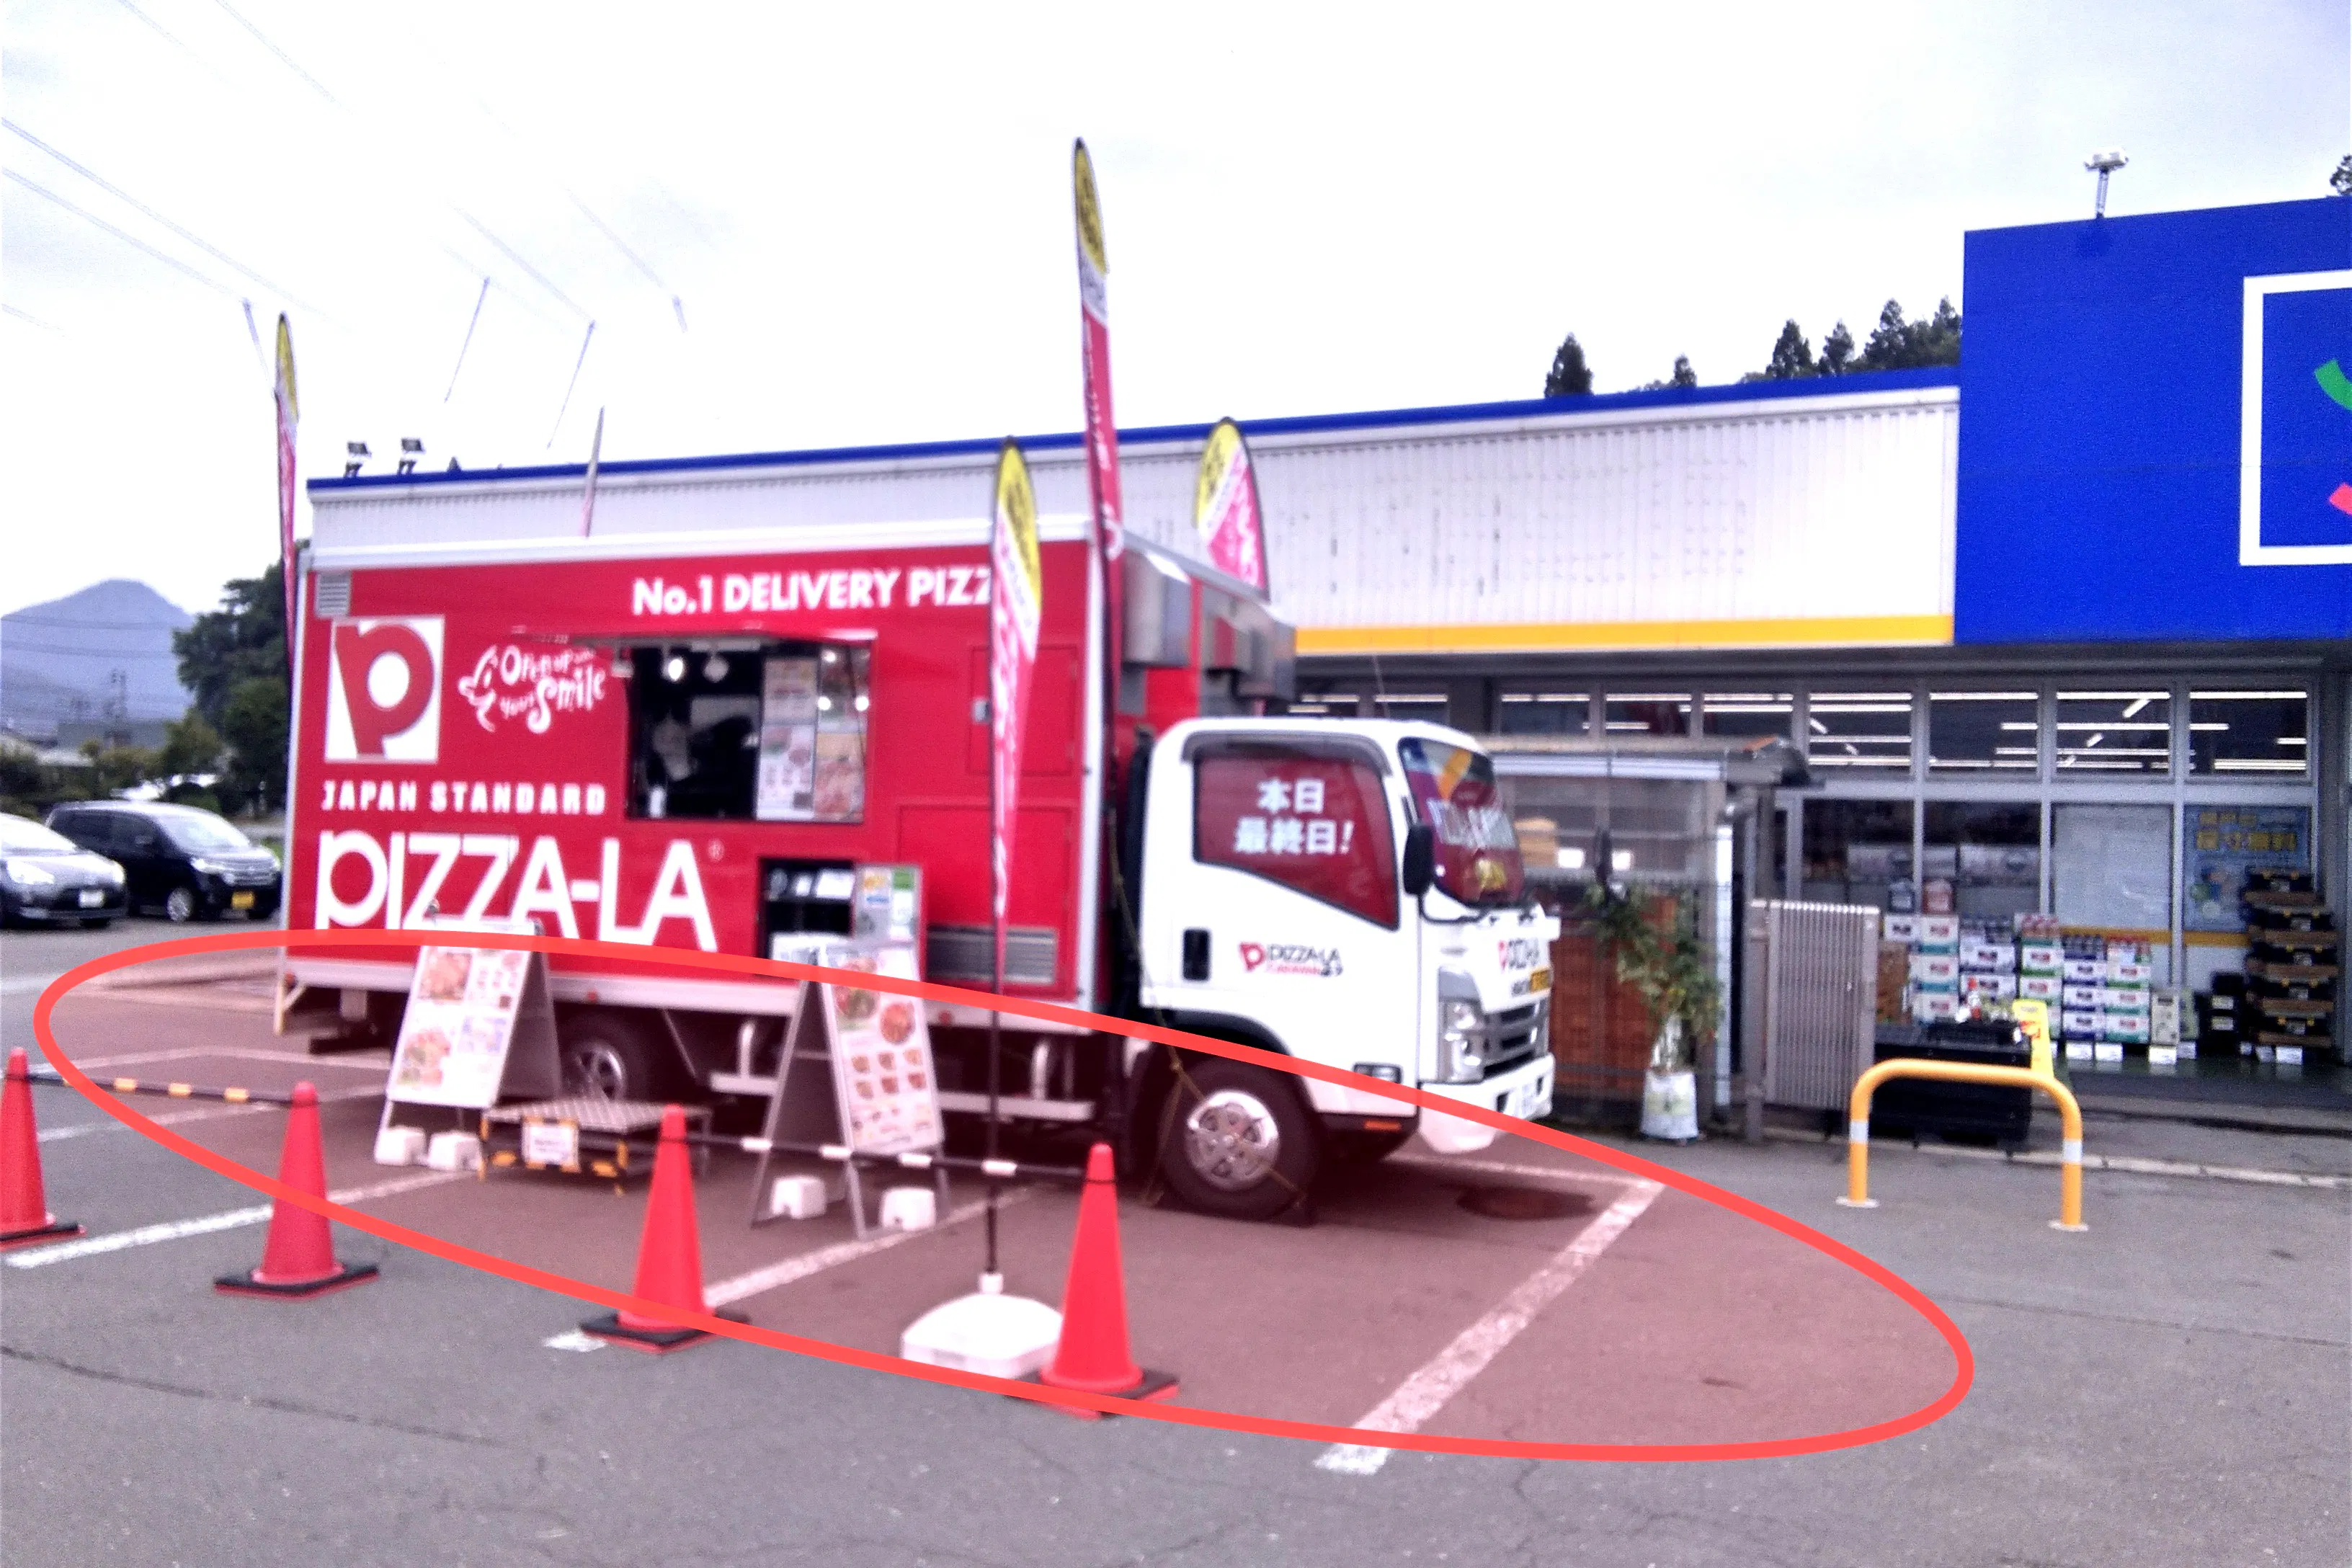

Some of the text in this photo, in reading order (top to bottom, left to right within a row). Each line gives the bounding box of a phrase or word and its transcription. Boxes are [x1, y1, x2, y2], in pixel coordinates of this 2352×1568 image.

[632, 566, 992, 615] No.1 DELIVERY PIZZ
[526, 663, 606, 734] Smile
[322, 780, 607, 816] JAPAN STANDARD
[1257, 778, 1325, 814] 本日
